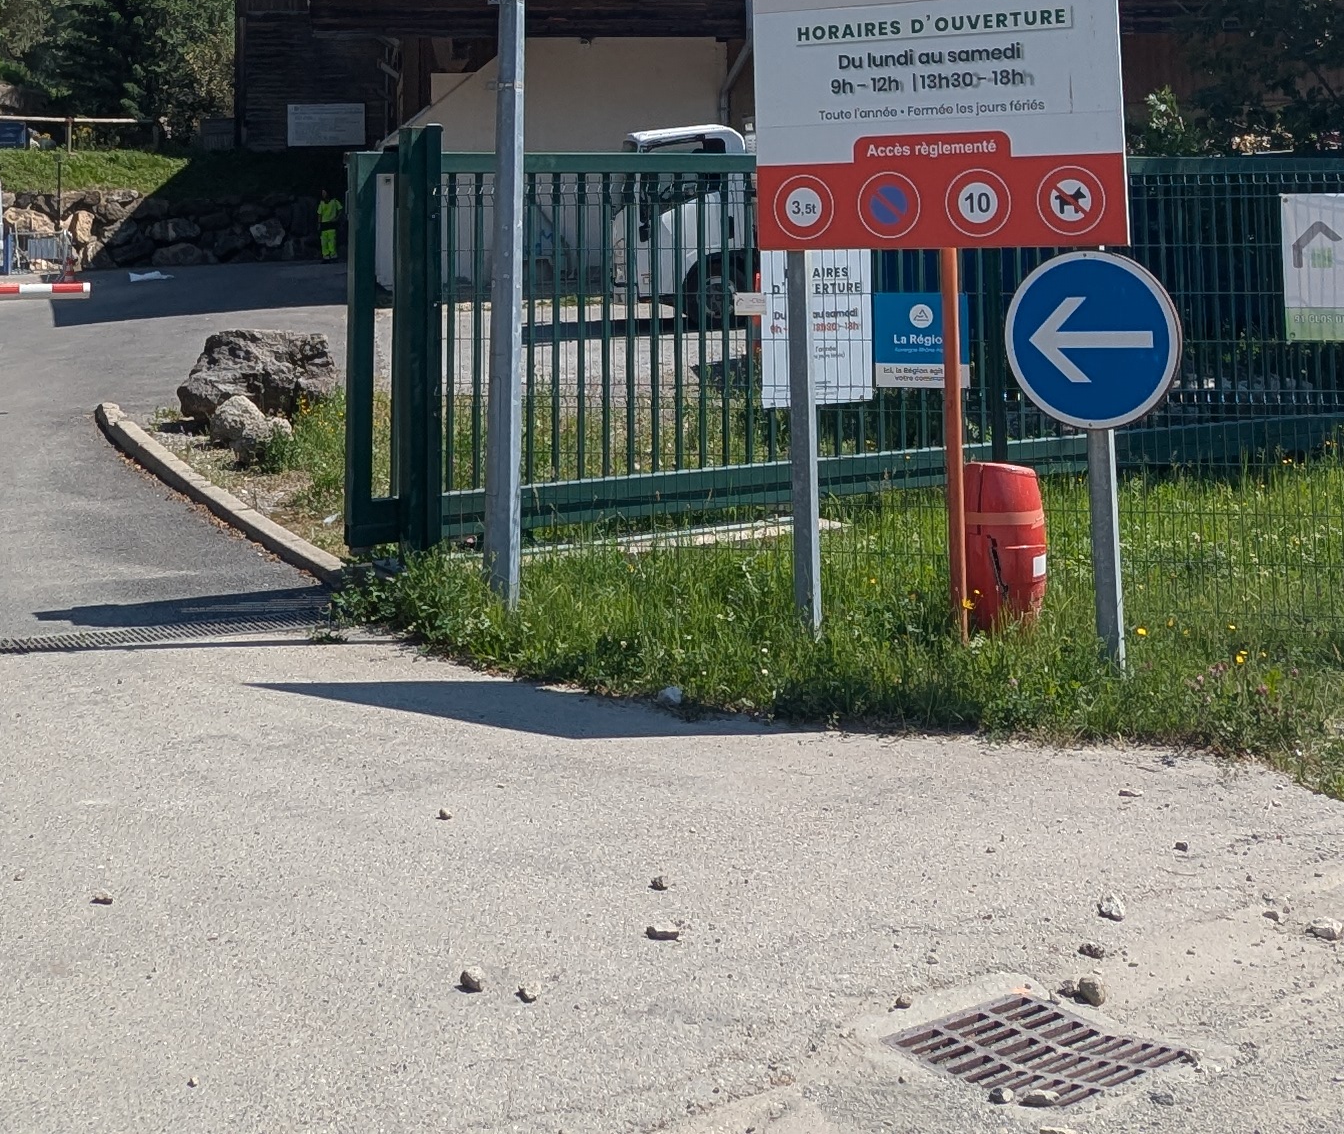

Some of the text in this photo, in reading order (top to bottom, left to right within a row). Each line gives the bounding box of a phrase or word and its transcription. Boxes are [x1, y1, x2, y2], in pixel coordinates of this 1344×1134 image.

[797, 8, 1066, 42] HORAIRES D'OUVERTURE
[838, 42, 1022, 70] Du lundi au samedi
[831, 78, 854, 95] 9h
[870, 75, 900, 92] 12h
[920, 71, 973, 89] 13h30
[992, 68, 1024, 86] 18h
[819, 110, 852, 121] Toute
[907, 103, 953, 116] Fermée
[956, 103, 974, 114] les
[975, 101, 1007, 116] jours
[1009, 99, 1045, 111] fériés
[866, 139, 997, 158] Accès règlementé
[791, 200, 817, 216] 3,5t
[964, 192, 991, 214] 10
[893, 334, 943, 346] La Régio
